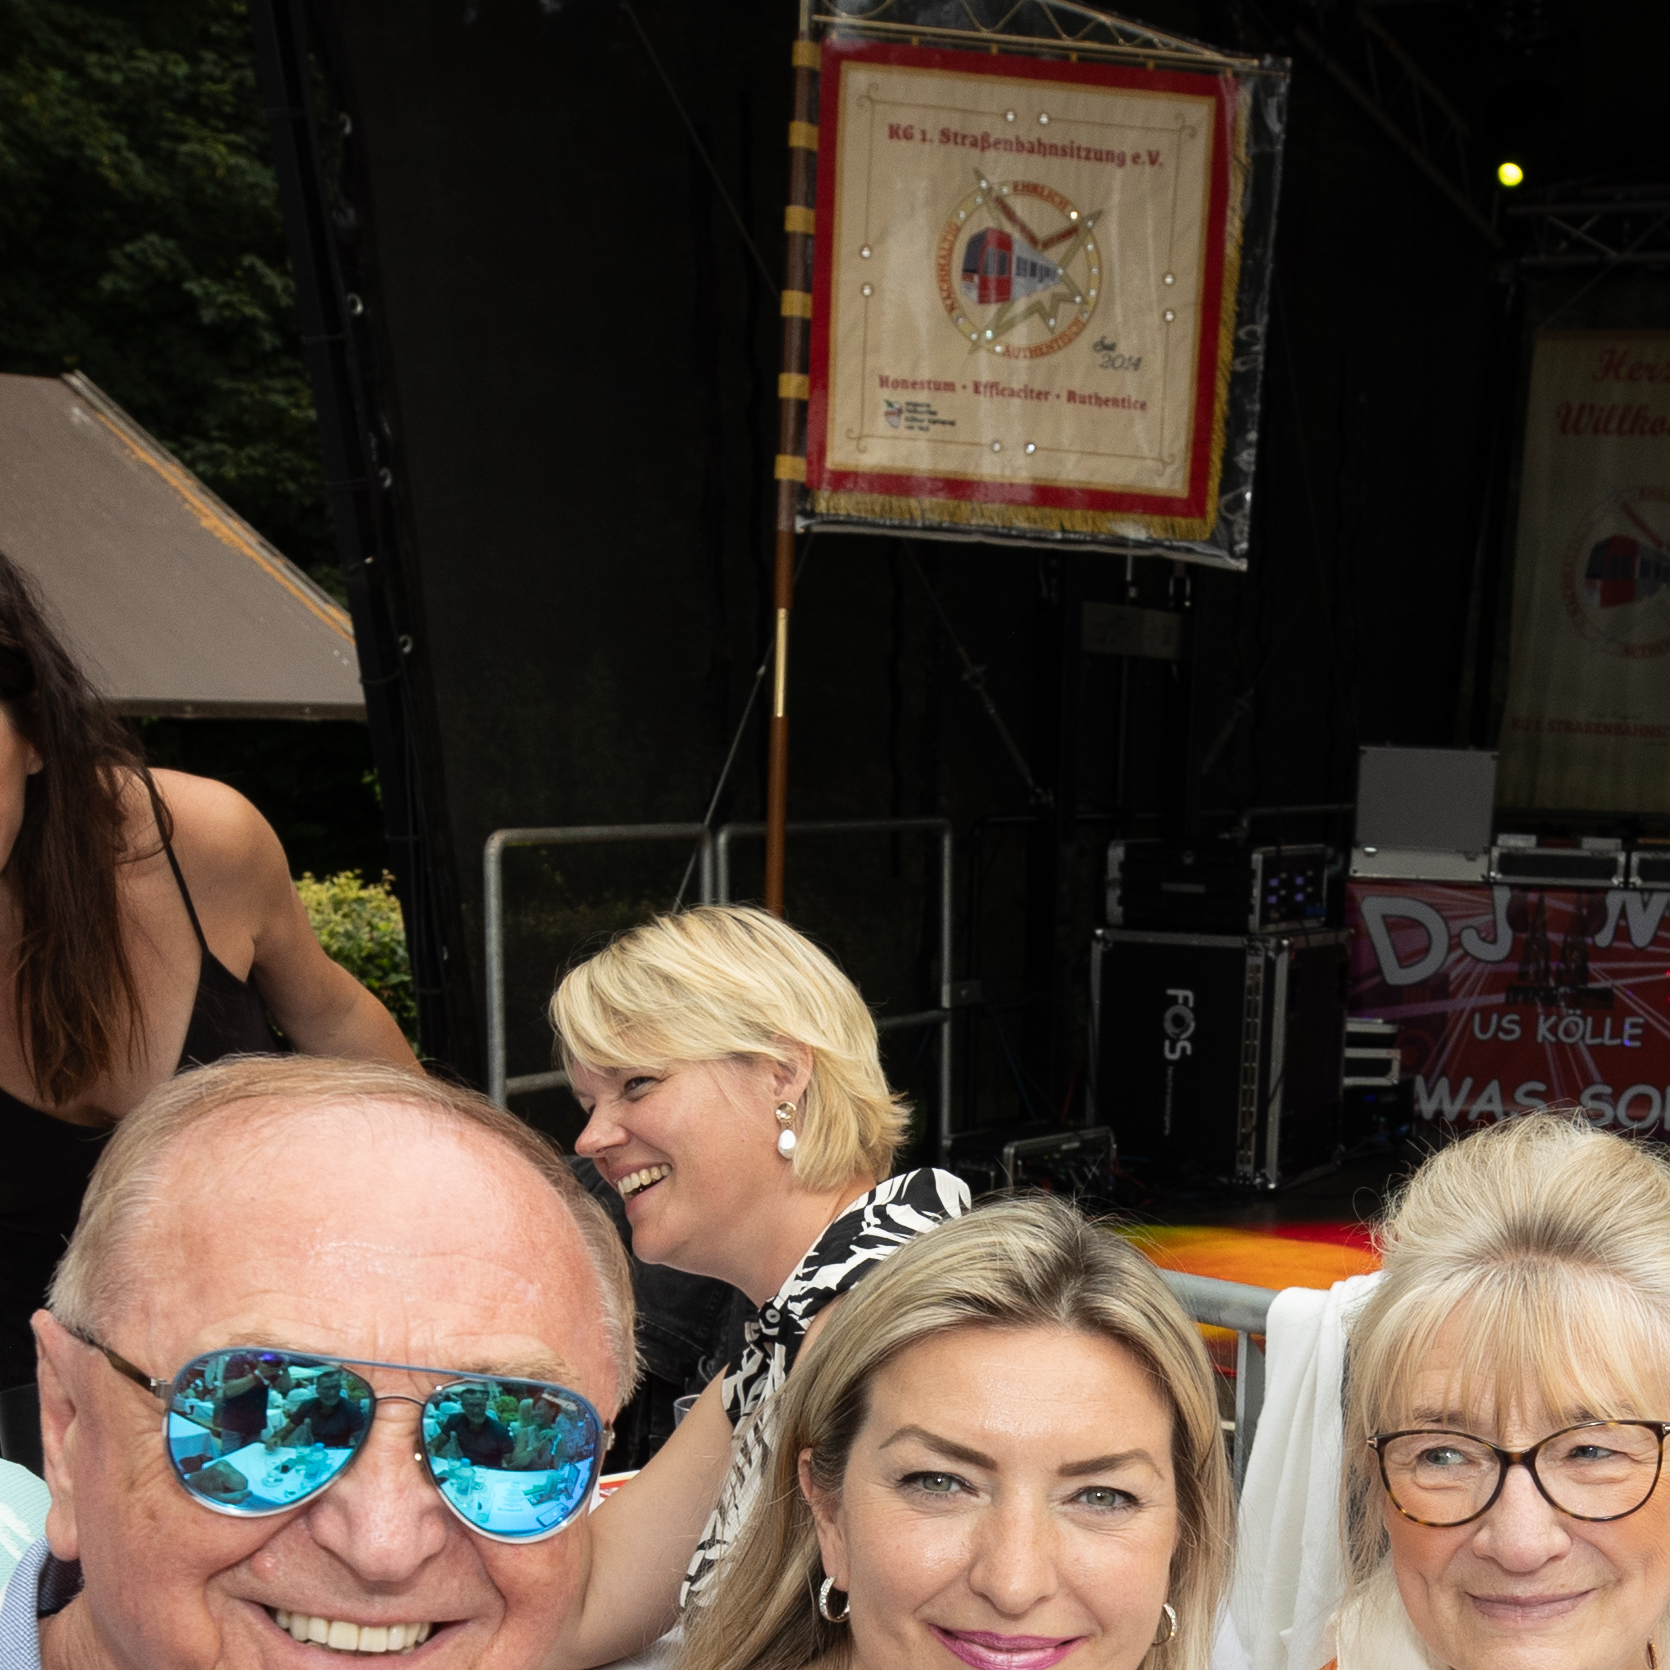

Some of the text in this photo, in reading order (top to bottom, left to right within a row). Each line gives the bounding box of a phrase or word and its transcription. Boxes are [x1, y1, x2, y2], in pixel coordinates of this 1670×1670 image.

[888, 123, 1164, 167] KG 1. Straßenbahnsitzung e.V.
[1099, 352, 1142, 371] 2014
[878, 375, 956, 393] Honestum
[972, 381, 1050, 403] Efficaciter
[1360, 887, 1514, 987] DJ
[1163, 987, 1196, 1062] FOS
[1472, 1008, 1646, 1049] US KÖLLE
[1415, 1073, 1548, 1121] WAS
